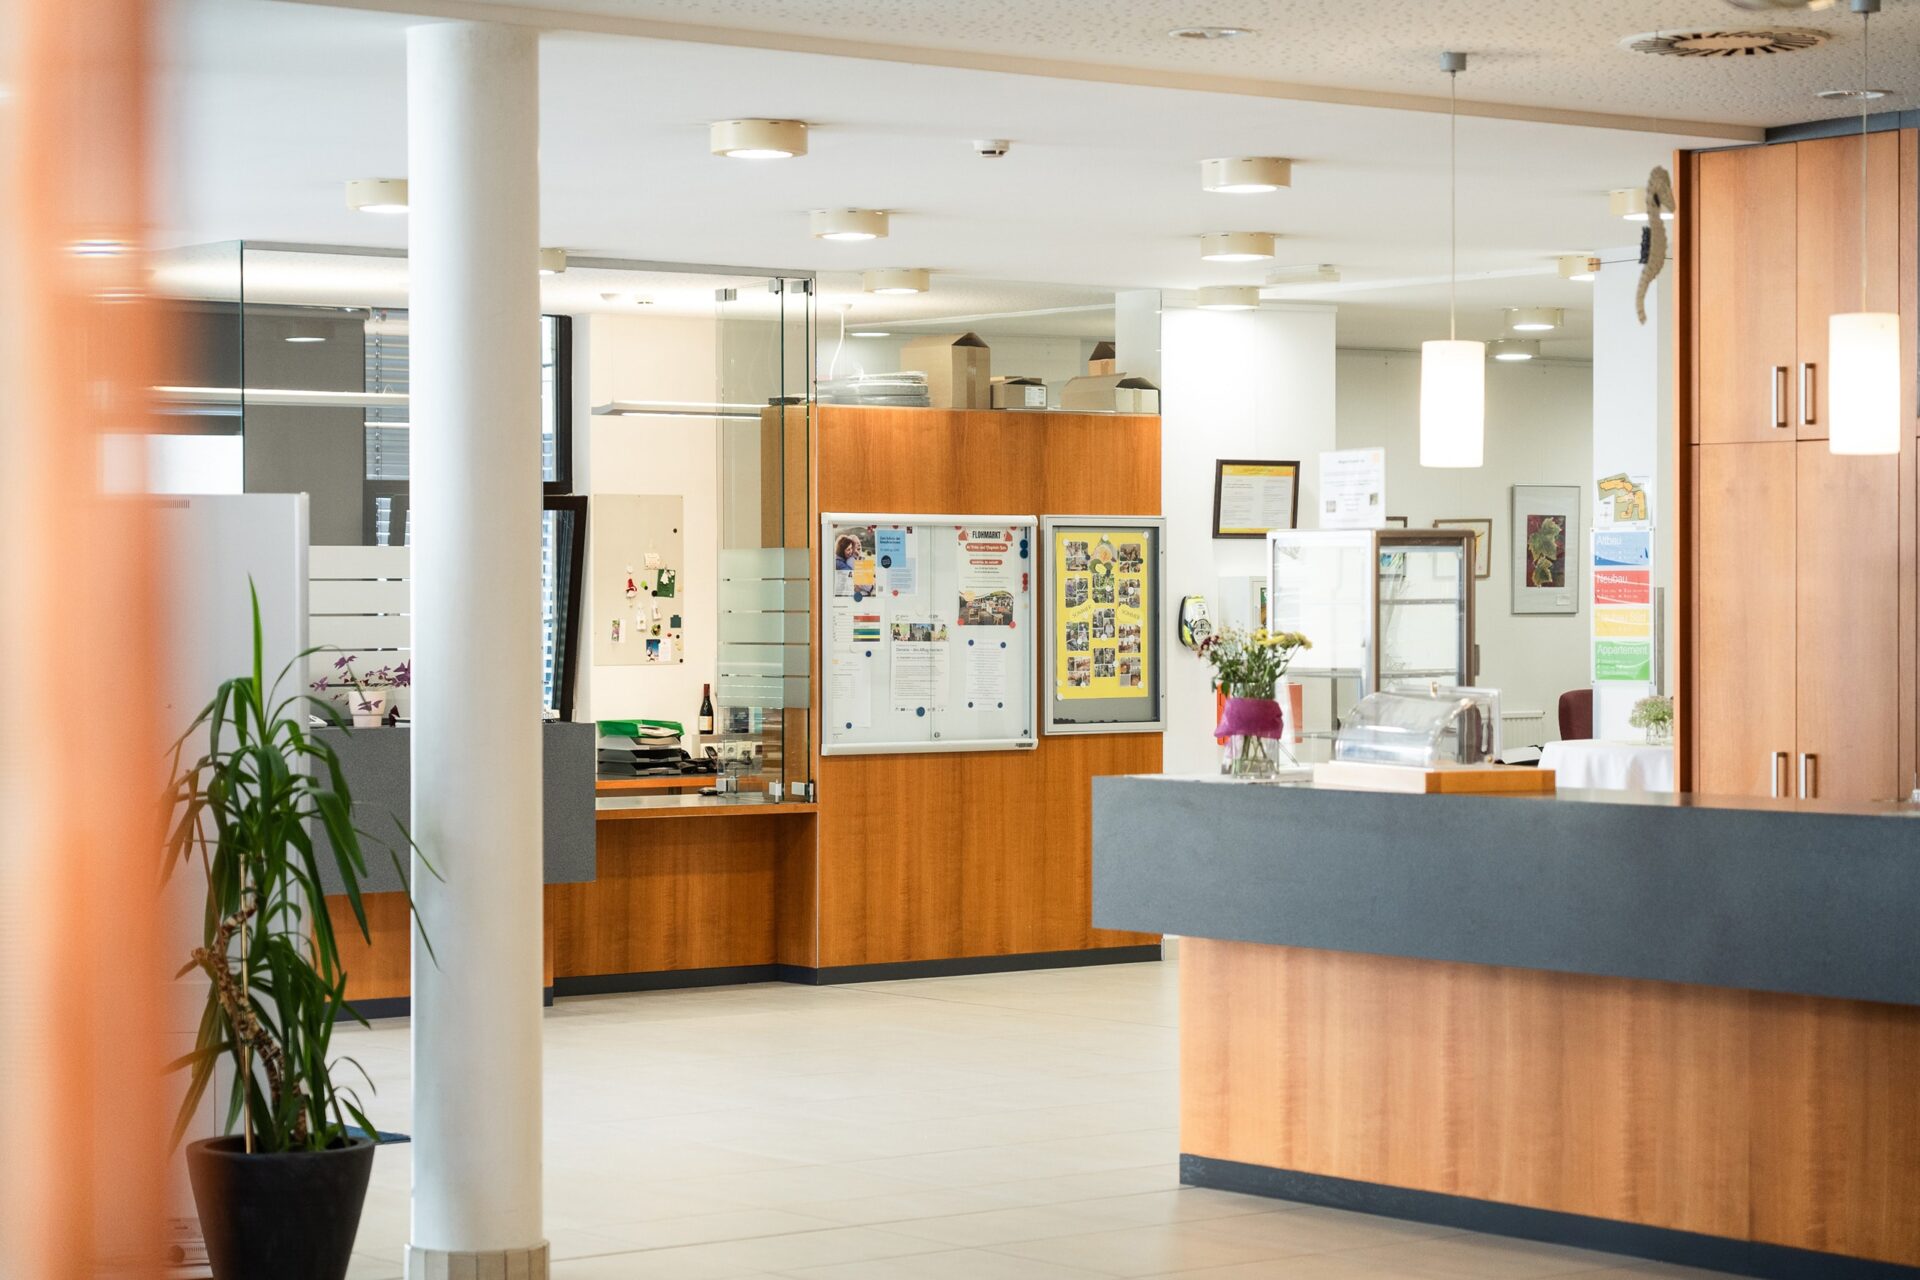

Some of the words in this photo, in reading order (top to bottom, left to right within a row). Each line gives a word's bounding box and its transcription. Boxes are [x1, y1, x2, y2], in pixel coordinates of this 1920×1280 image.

[972, 530, 1001, 539] FLOHMARKT
[1596, 535, 1622, 545] Altbau
[1596, 574, 1628, 585] Neubau
[1596, 644, 1648, 656] Appartement
